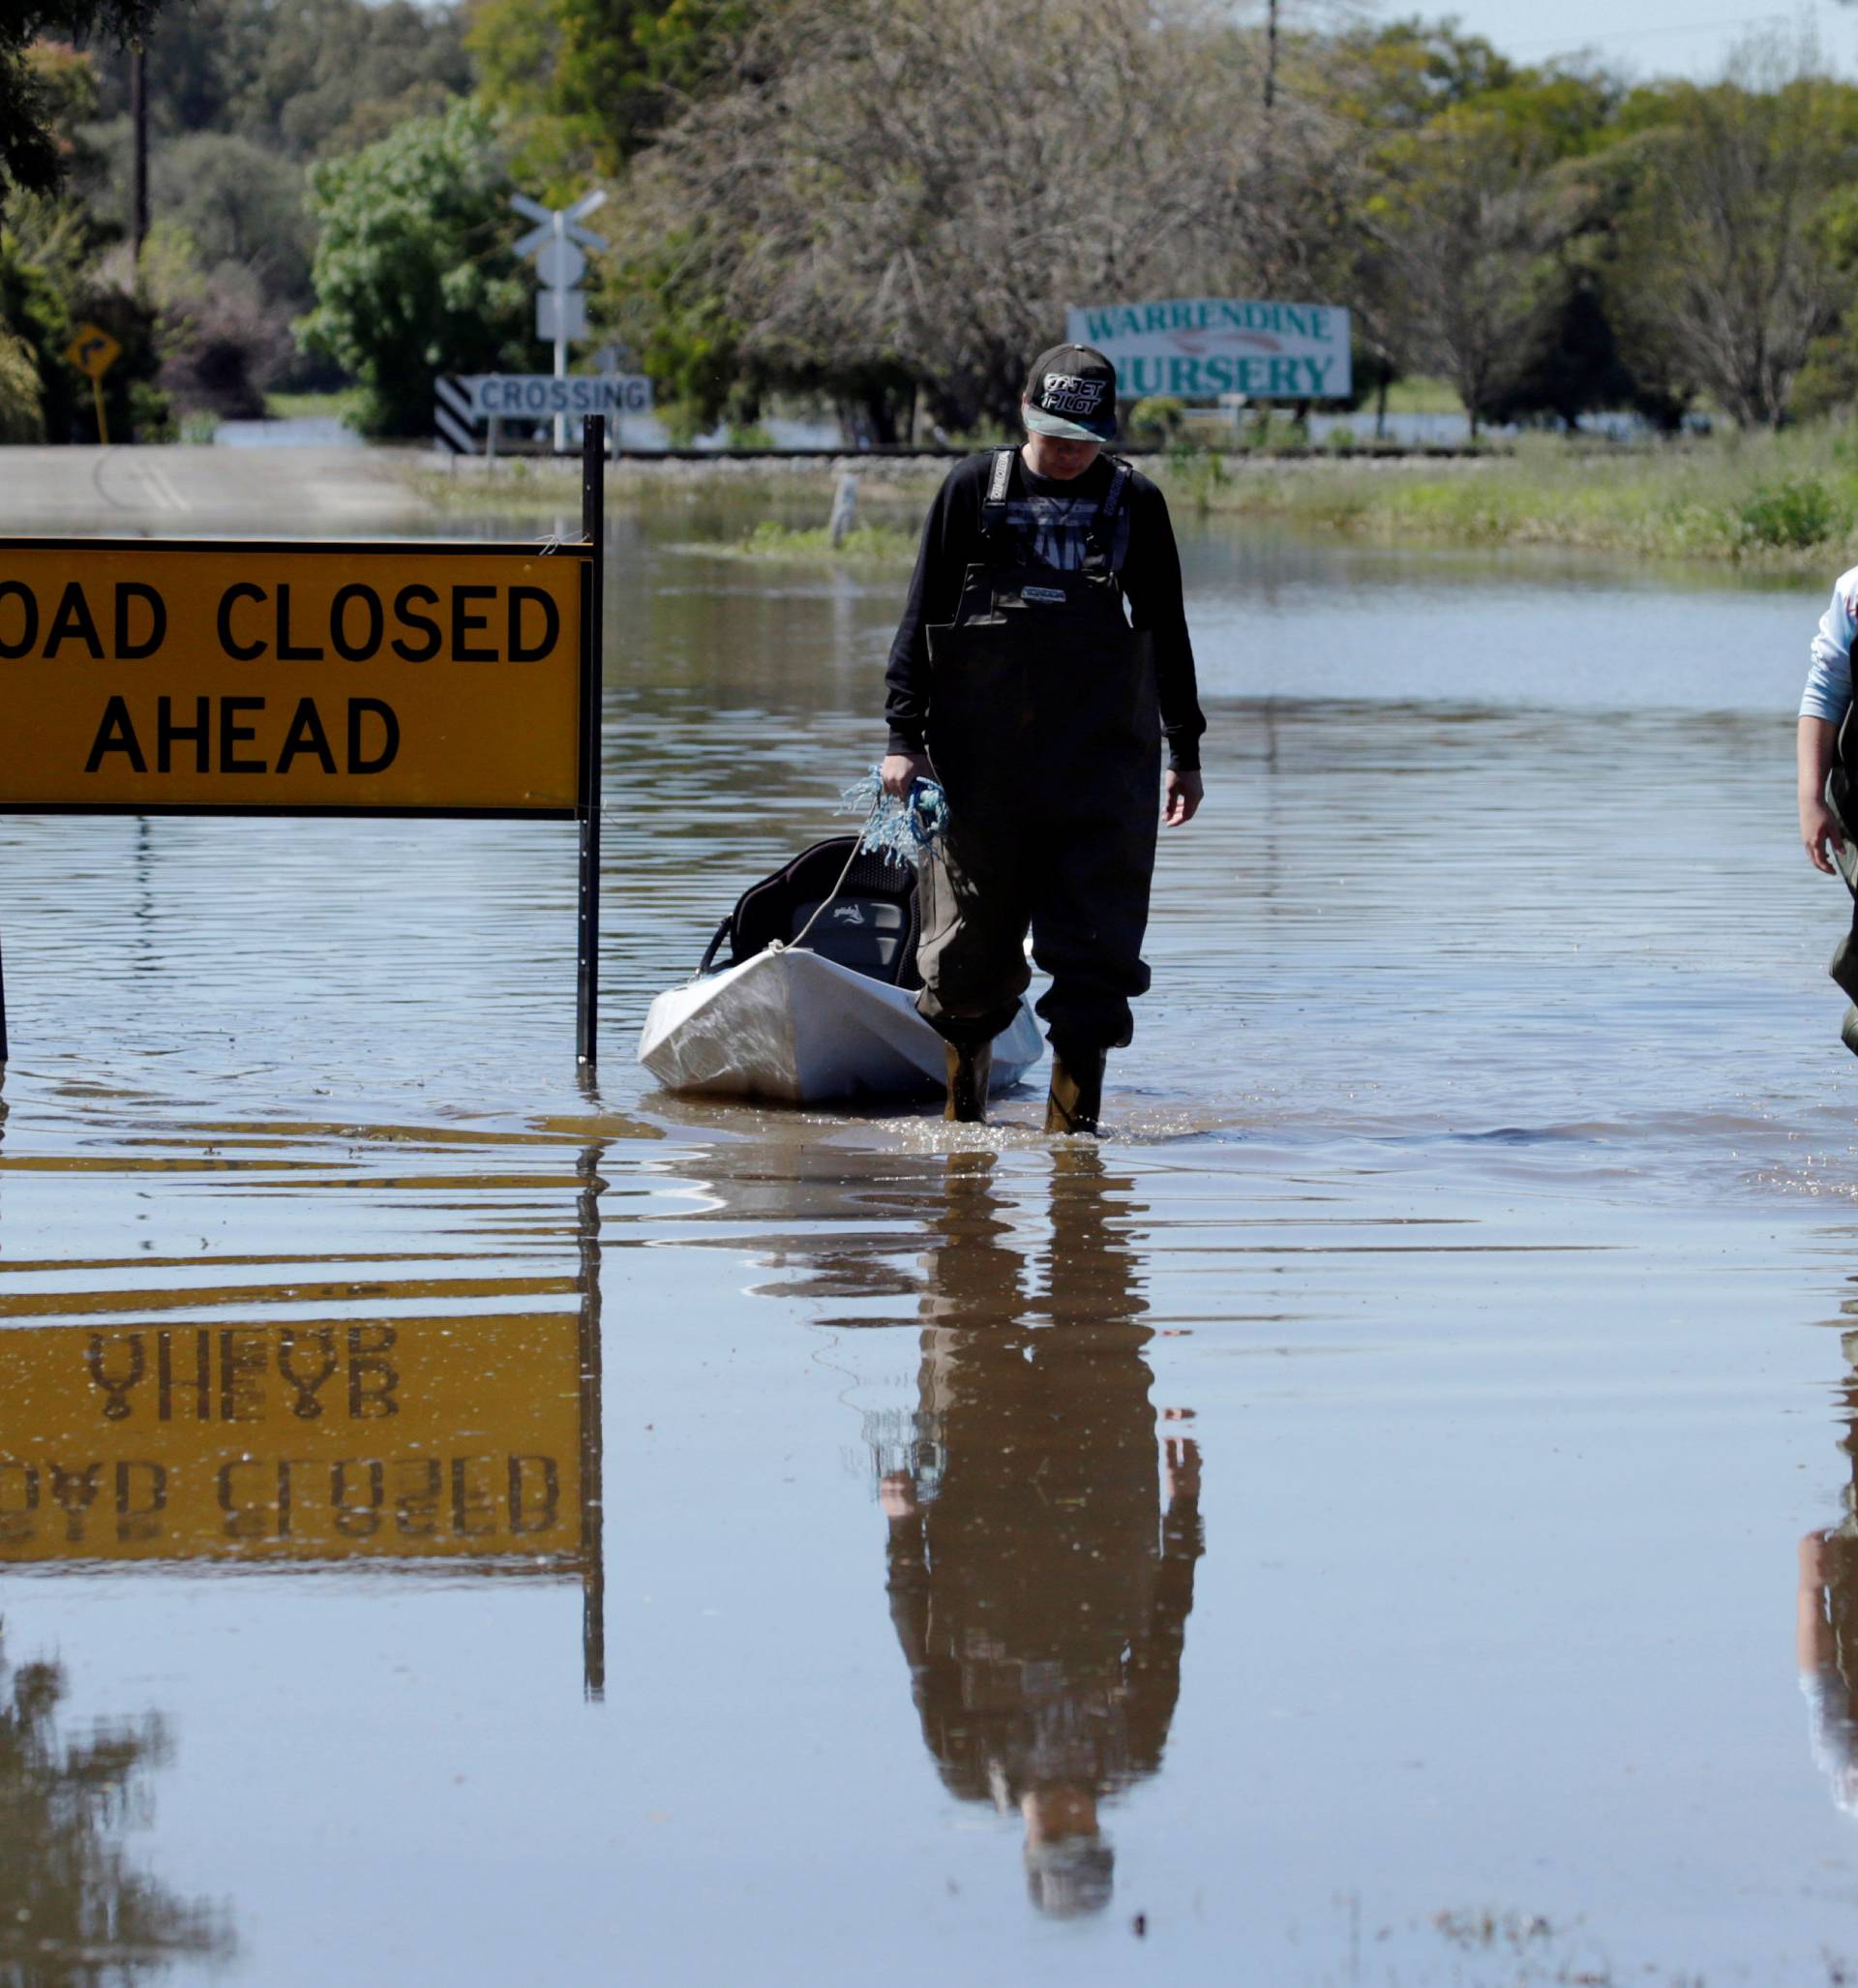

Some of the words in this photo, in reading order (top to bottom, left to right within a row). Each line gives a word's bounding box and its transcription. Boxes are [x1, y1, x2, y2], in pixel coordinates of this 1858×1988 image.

[1085, 301, 1334, 343] WARRENDINE
[480, 379, 645, 411] CROSSING
[1041, 392, 1101, 414] PILOT
[1067, 377, 1106, 397] JET
[0, 581, 167, 659] OAD
[216, 583, 560, 663] CLOSED
[84, 695, 401, 774] AHEAD
